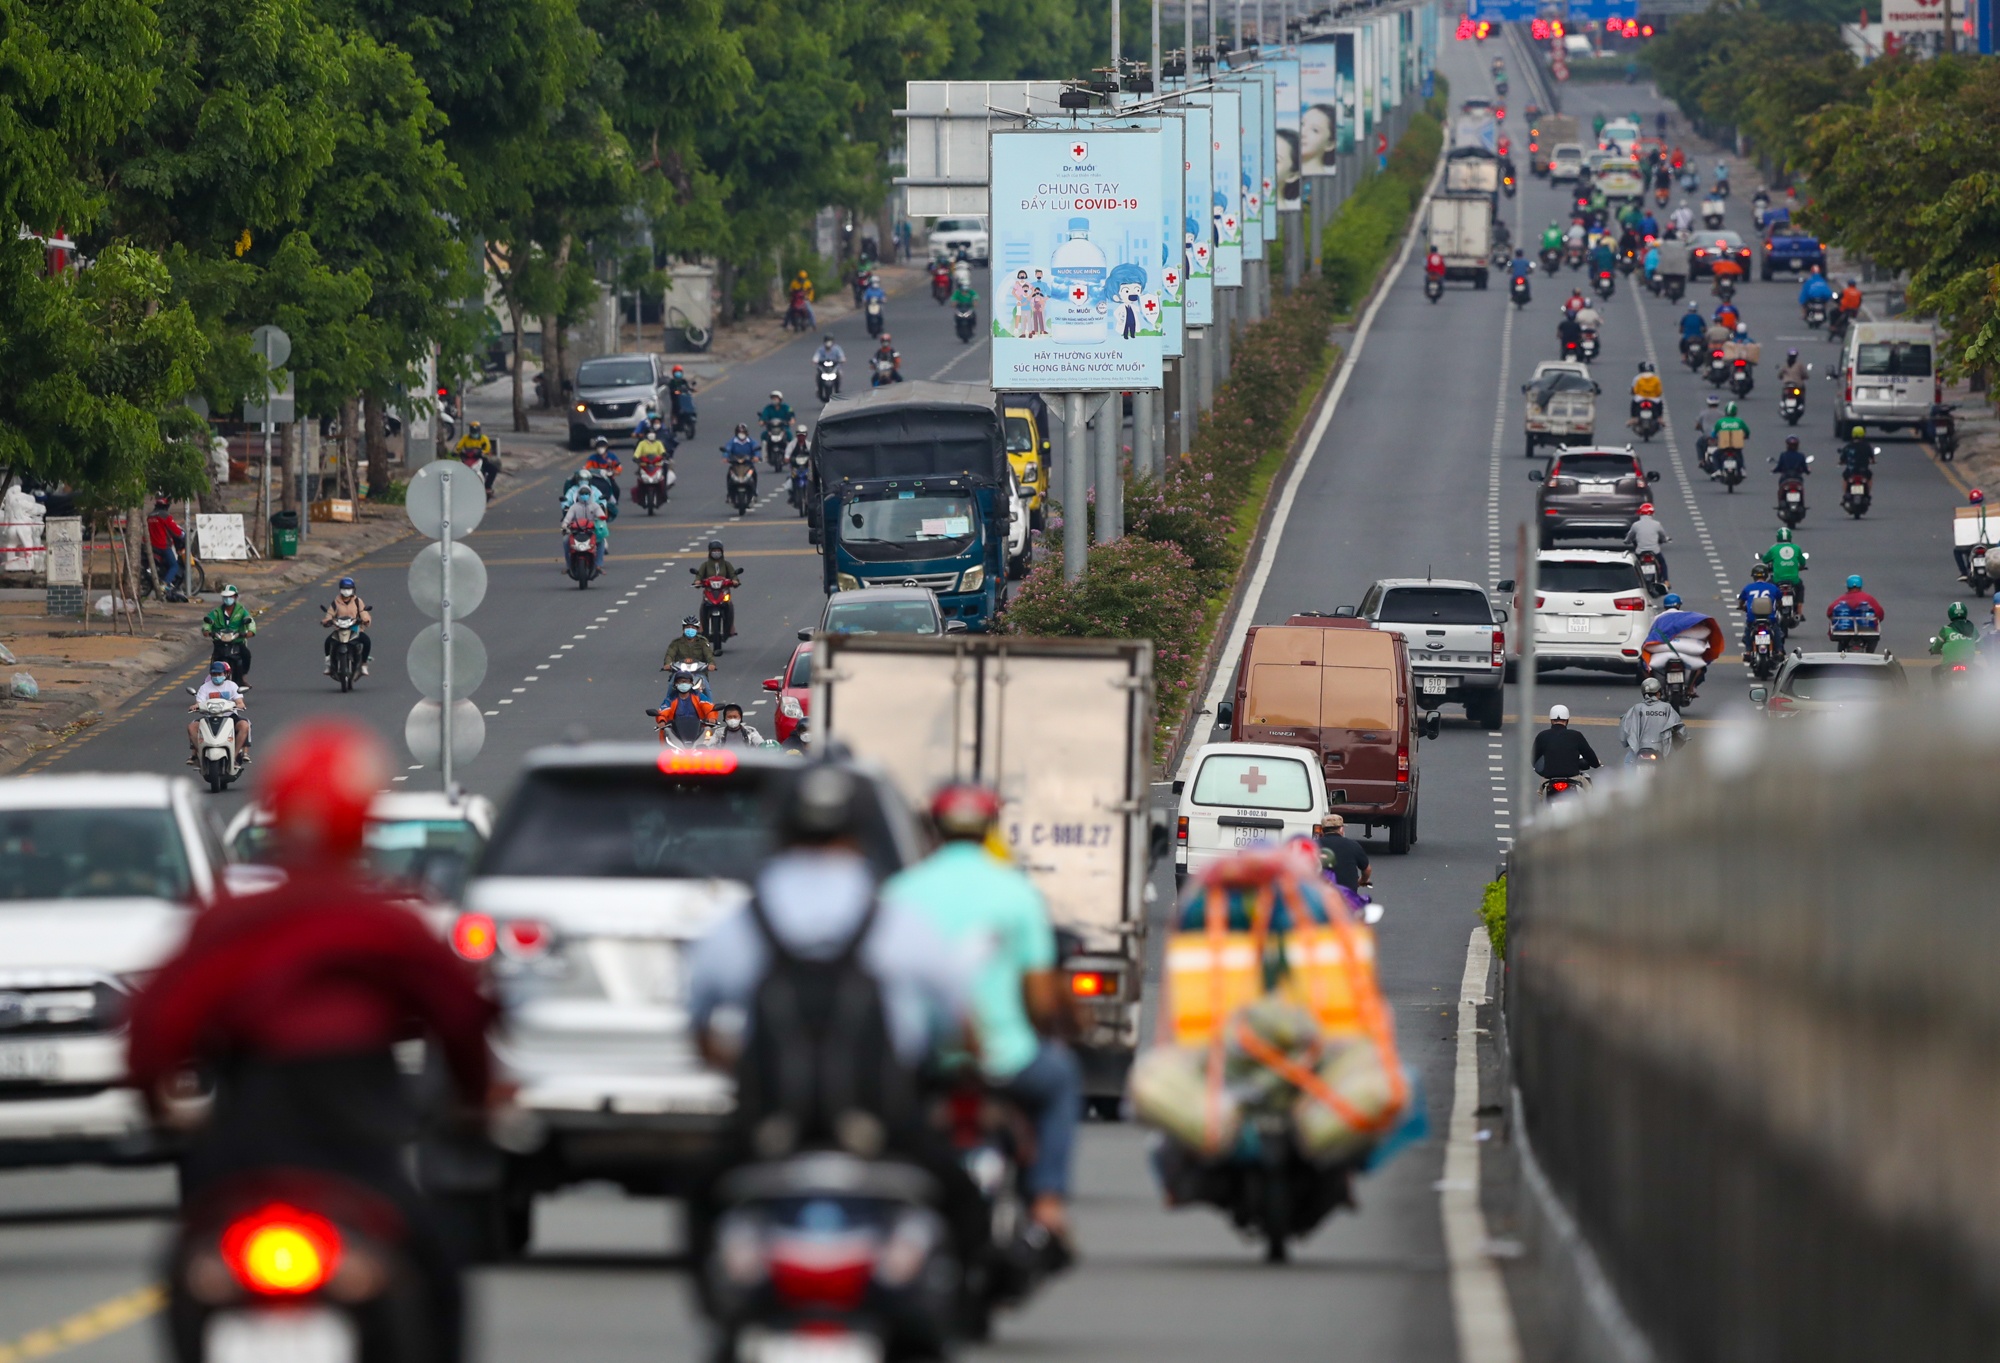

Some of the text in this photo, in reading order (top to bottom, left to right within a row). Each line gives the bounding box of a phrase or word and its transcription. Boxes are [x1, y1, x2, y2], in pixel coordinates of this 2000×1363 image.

[1038, 183, 1119, 195] CHUNG TAY
[1021, 195, 1138, 210] ĐẨY LÙI COVID-19
[1034, 350, 1123, 360] HÃY THƯỜNG XUYÊN
[1013, 363, 1030, 372] SÚC
[1032, 364, 1059, 374] HỌNG
[1088, 363, 1114, 372] NƯỚC
[1645, 710, 1668, 718] BOSCH
[1242, 827, 1259, 838] 51D
